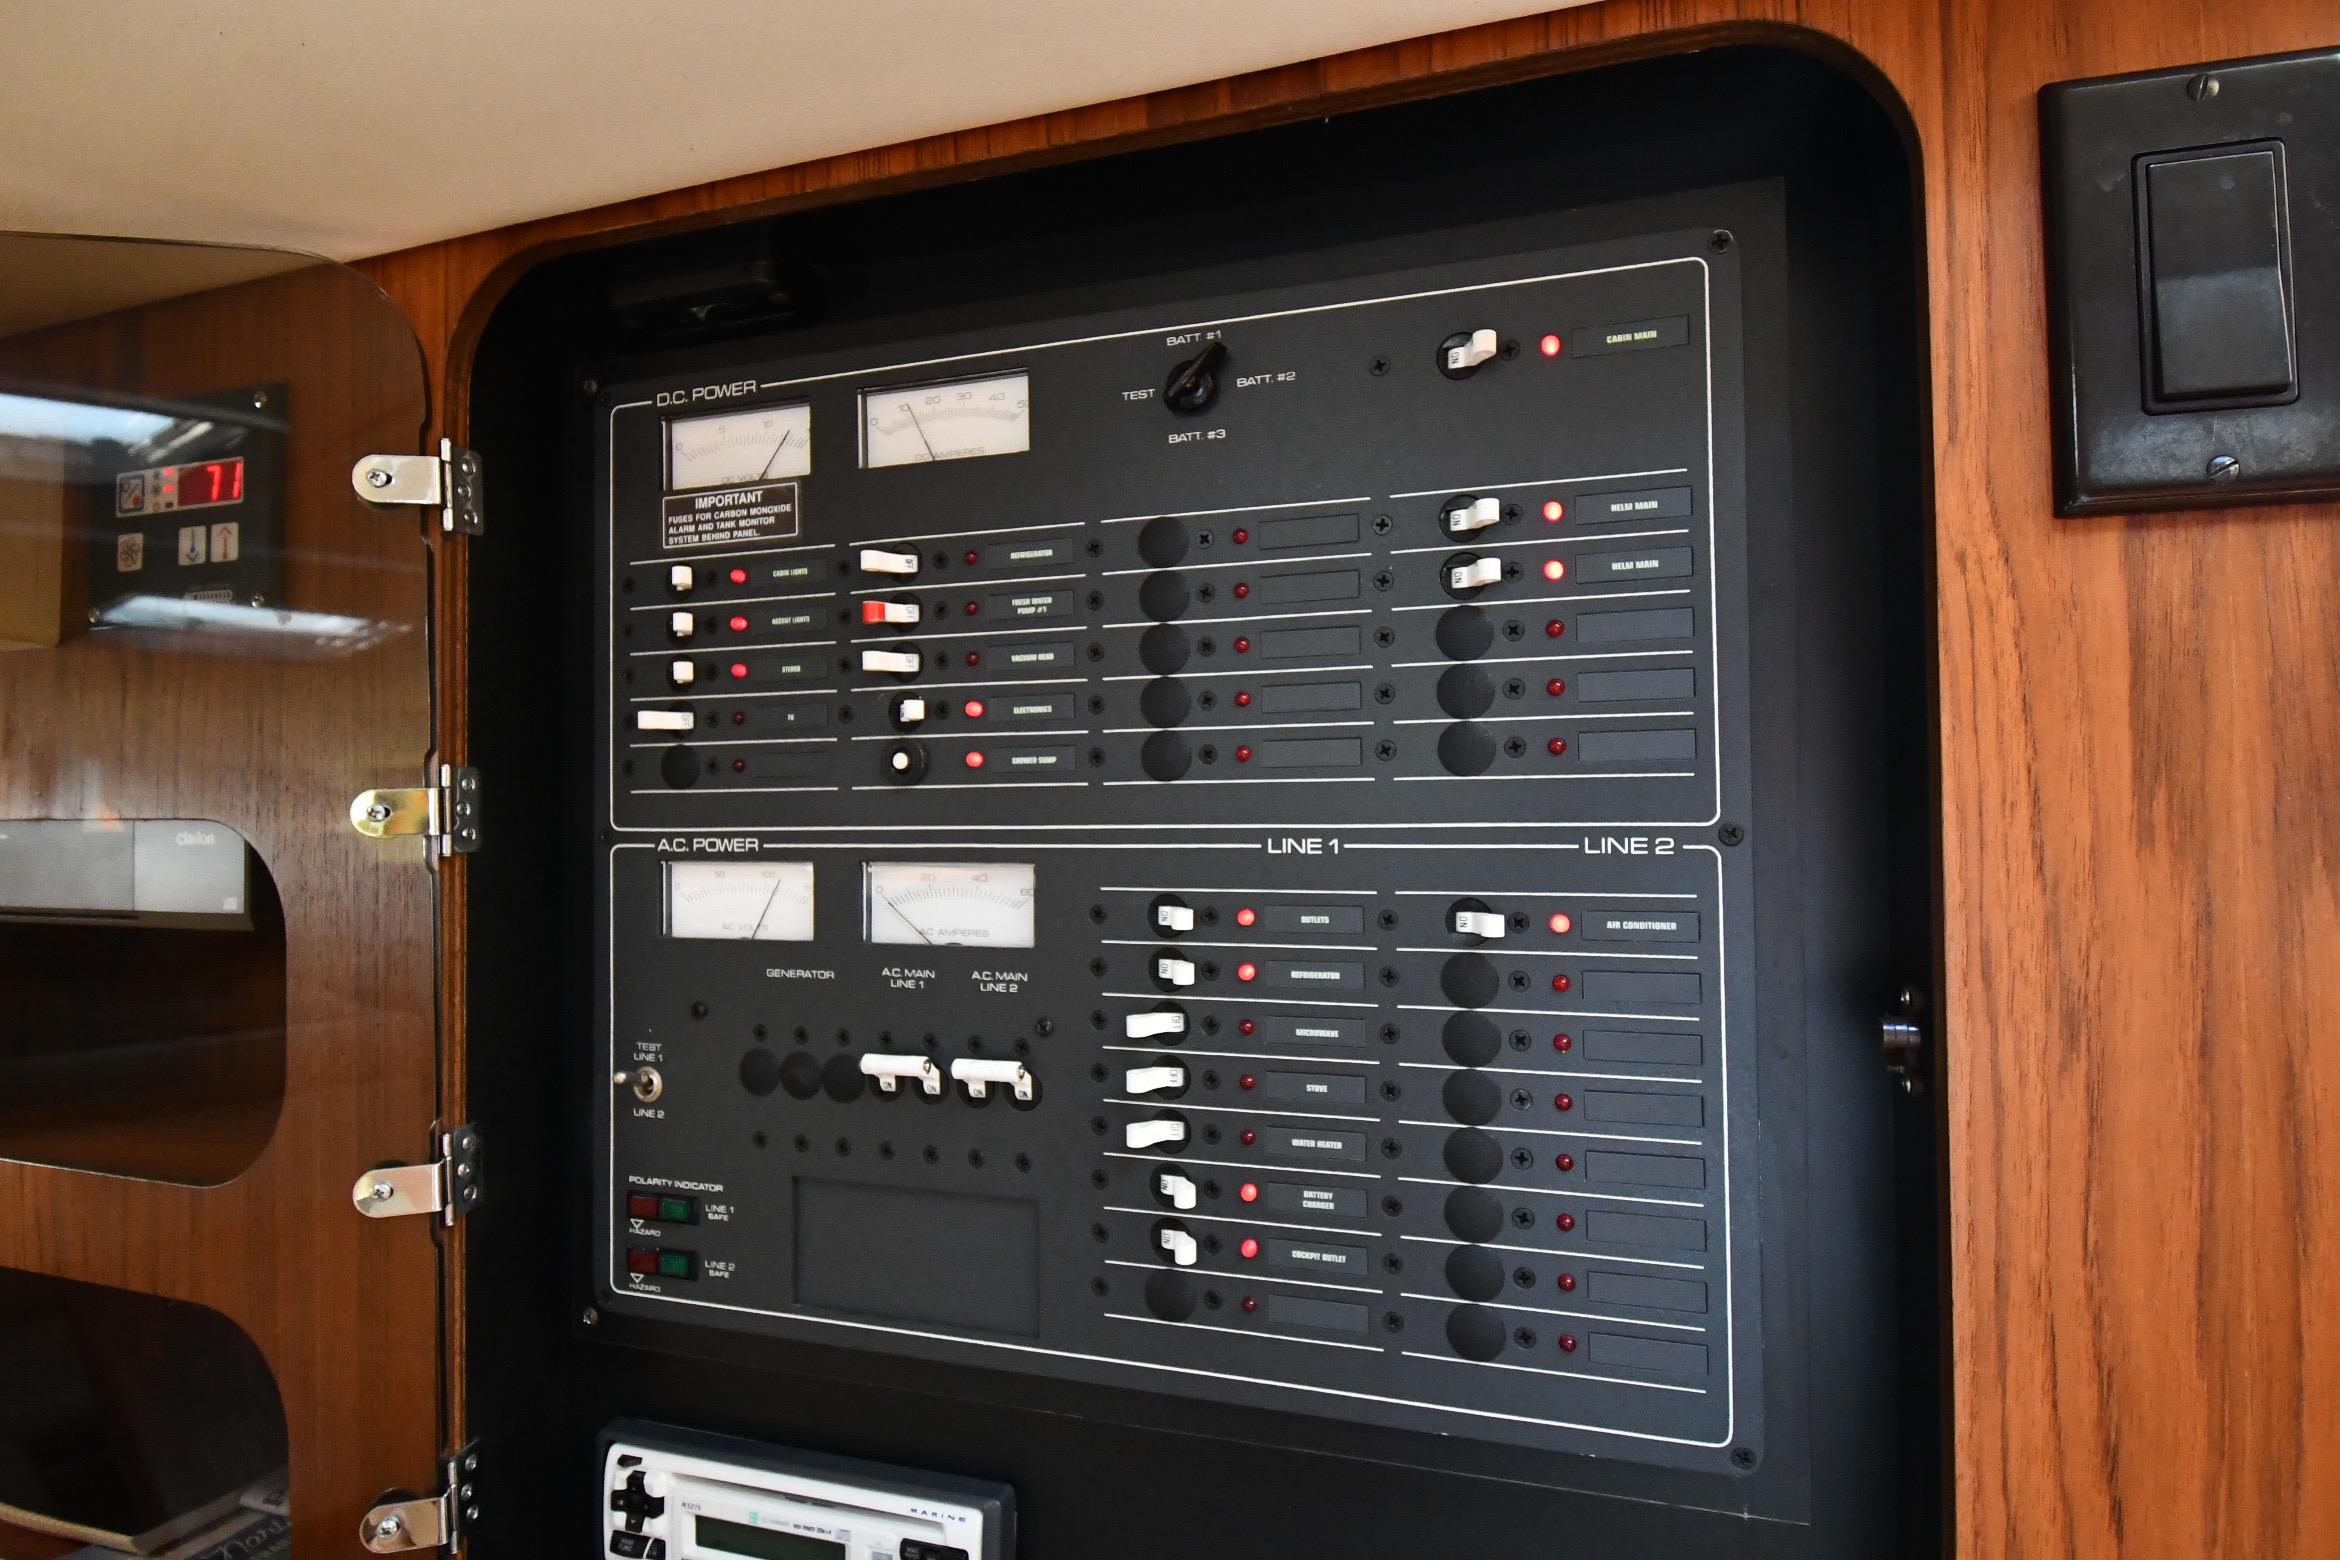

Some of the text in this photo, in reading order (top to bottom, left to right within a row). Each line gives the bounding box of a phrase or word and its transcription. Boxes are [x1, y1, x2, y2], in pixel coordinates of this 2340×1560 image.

[1206, 330, 1222, 340] #1
[1606, 330, 1657, 343] CABIN MAIN
[1236, 372, 1296, 387] BATT. #2
[657, 380, 757, 406] D.C. POWER
[957, 392, 972, 401] 30
[1122, 389, 1156, 400] TEST
[925, 396, 941, 405] 20
[1168, 429, 1226, 444] BATT. #3
[206, 462, 243, 502] 71
[695, 490, 763, 509] IMPORTANT
[1635, 500, 1658, 509] MAIN
[668, 503, 792, 524] FUSES FOR CARBON MONOXIDE
[668, 516, 775, 534] ALARM AND TANK MONITOR
[668, 534, 699, 545] SYSTEM
[701, 531, 731, 542] BEHIND
[1636, 559, 1659, 568] MAIN
[658, 838, 758, 852] A.C. POWER
[1268, 838, 1338, 854] LINE 1
[1584, 837, 1674, 854] LINE 2
[971, 873, 988, 882] 40
[1623, 921, 1677, 930] CONDITIONER
[937, 929, 990, 937] AMPERES
[766, 968, 835, 979] GENERATOR
[881, 967, 935, 978] A.C. MAIN
[996, 972, 1028, 982] MAIN
[890, 980, 917, 988] LINE
[980, 983, 1018, 992] LINE 2
[633, 1053, 655, 1061] LINE
[1306, 1084, 1328, 1093] STOVE
[633, 1108, 655, 1117] LINE
[629, 1176, 723, 1192] POLARITY INDICATOR
[1303, 1190, 1333, 1199] BATTERY
[705, 1205, 728, 1213] LINE
[1302, 1200, 1334, 1210] CHARGER
[705, 1260, 726, 1269] LINE
[910, 1507, 967, 1523] MARINE
